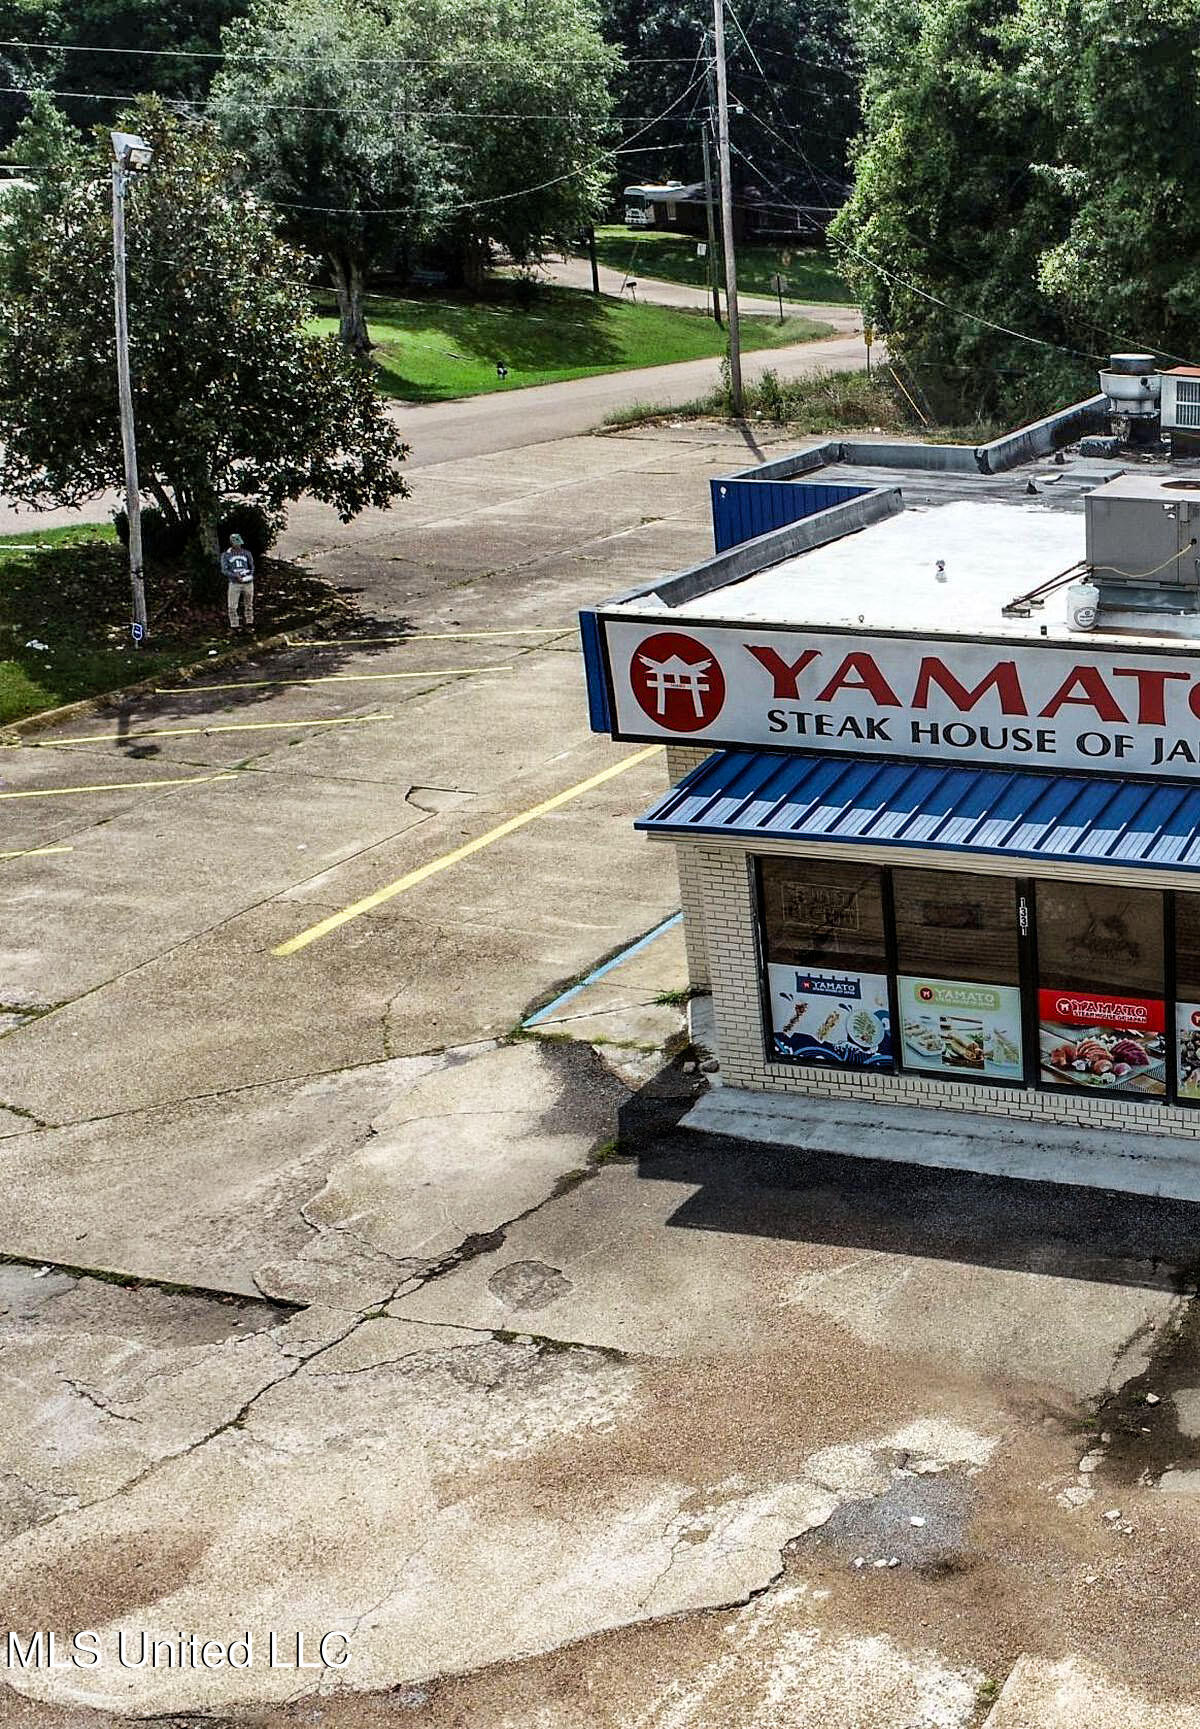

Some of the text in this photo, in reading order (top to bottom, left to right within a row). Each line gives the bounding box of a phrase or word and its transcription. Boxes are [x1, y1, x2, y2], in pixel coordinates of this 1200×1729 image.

[767, 709, 893, 741] STEAK
[911, 721, 1057, 754] HOUSE
[1076, 732, 1134, 758] OF
[811, 980, 856, 992] YAMATO
[934, 987, 995, 1003] YAMATO
[1071, 999, 1148, 1017] YAMATO
